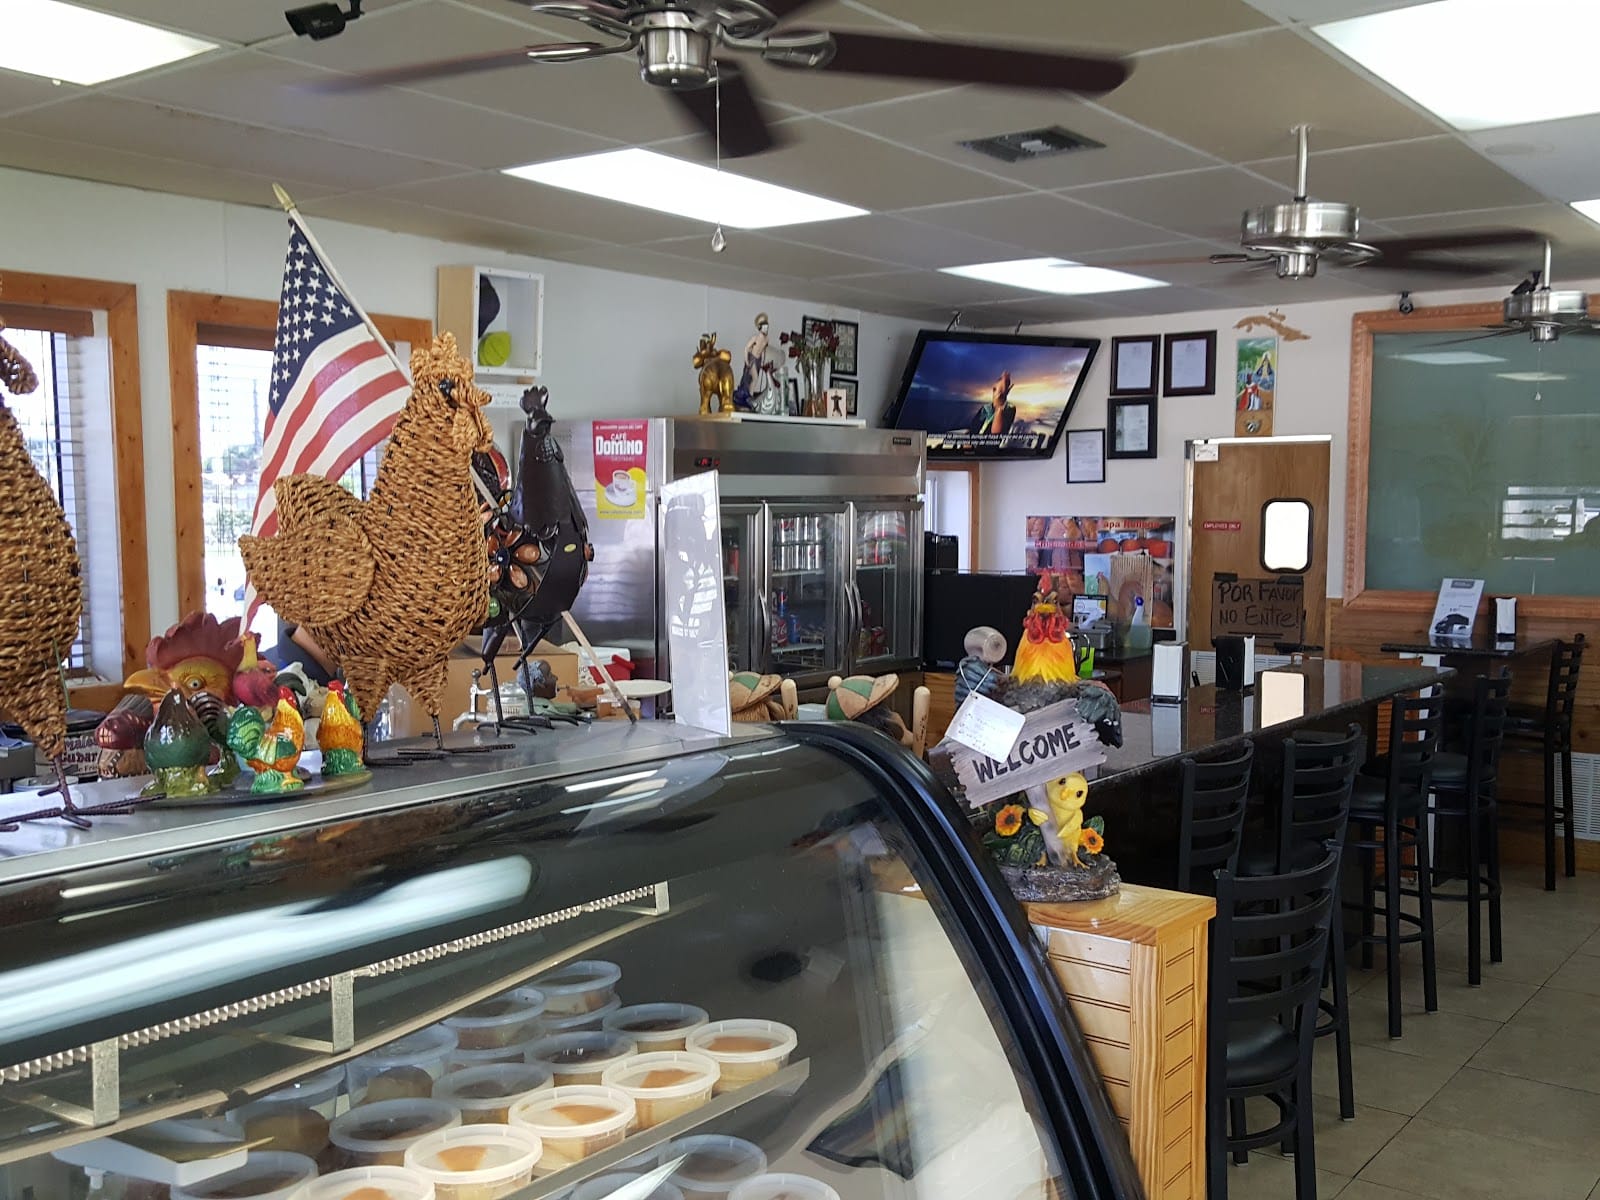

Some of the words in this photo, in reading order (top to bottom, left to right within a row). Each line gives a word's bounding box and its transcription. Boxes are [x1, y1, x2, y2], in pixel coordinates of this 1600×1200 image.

[1217, 582, 1254, 604] POR
[1219, 609, 1238, 625] NO
[972, 722, 1081, 783] WELCOME
